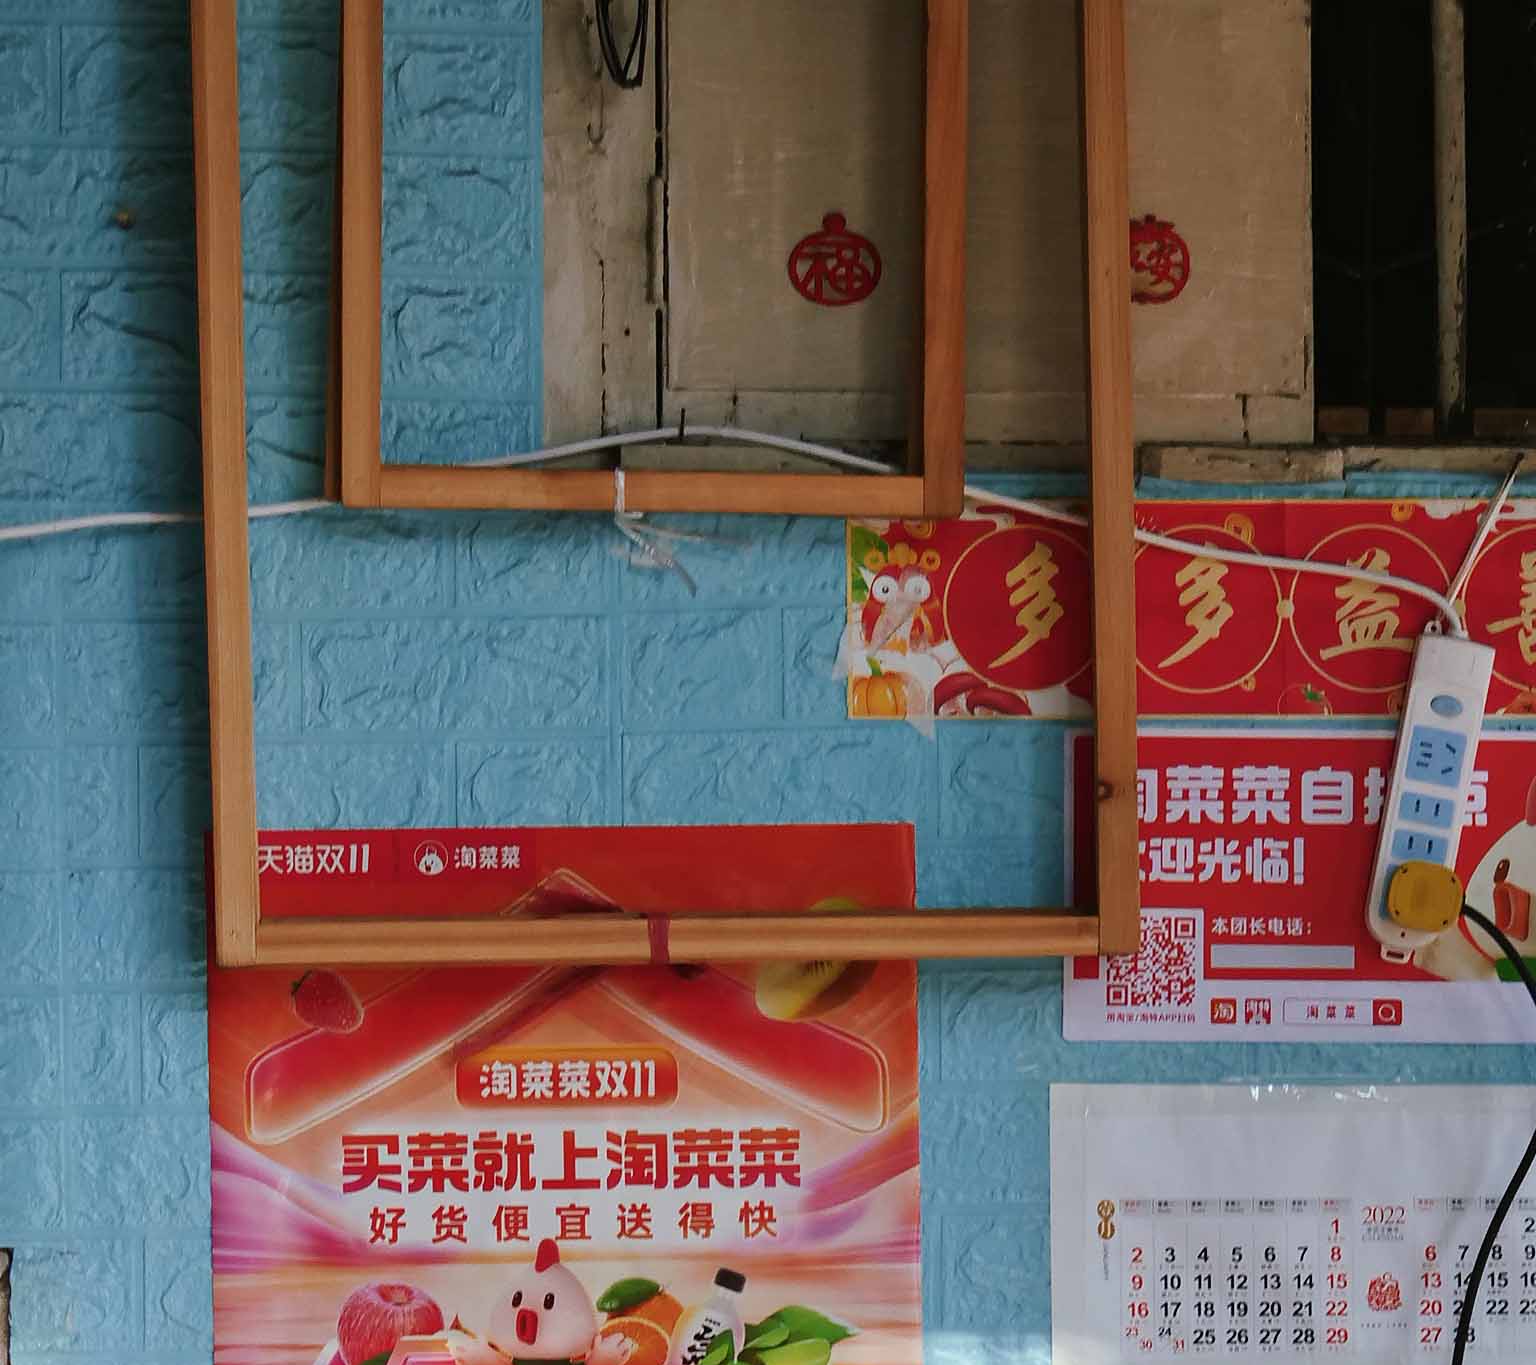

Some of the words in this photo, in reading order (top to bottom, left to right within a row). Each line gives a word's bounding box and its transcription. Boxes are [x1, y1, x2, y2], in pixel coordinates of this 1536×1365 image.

[258, 842, 370, 875] 天猫双11
[453, 844, 522, 871] 淘菜菜
[1138, 837, 1305, 886] 迎光临!
[479, 1059, 657, 1099] 淘菜菜双11
[341, 1127, 801, 1193] 买菜就上淘菜菜
[369, 1200, 778, 1245] 好货便宜送得快
[1362, 1206, 1407, 1226] 2022
[1524, 1216, 1536, 1233] 2
[1331, 1218, 1339, 1234] 1
[1131, 1246, 1143, 1264] 2
[1164, 1246, 1176, 1263] 3
[1197, 1246, 1210, 1263] 4
[1231, 1246, 1243, 1263] 5
[1264, 1245, 1276, 1263] 6
[1297, 1245, 1309, 1263] 7
[1330, 1245, 1342, 1263] 8
[1424, 1245, 1437, 1262] 6
[1458, 1244, 1470, 1262] 7
[1491, 1244, 1503, 1262] 8
[1524, 1244, 1536, 1261] 9
[1131, 1274, 1144, 1291] 9
[1159, 1273, 1182, 1291] 10
[1193, 1273, 1212, 1291] 11
[1226, 1273, 1248, 1291] 12
[1259, 1273, 1282, 1291] 13
[1293, 1273, 1315, 1291] 14
[1326, 1272, 1348, 1290] 15
[1420, 1271, 1442, 1289] 13
[1487, 1271, 1509, 1289] 15
[1127, 1301, 1149, 1319] 16
[1159, 1301, 1182, 1319] 17
[1193, 1300, 1216, 1318] 18
[1226, 1300, 1249, 1318] 19
[1258, 1300, 1282, 1318] 20
[1292, 1300, 1313, 1318] 21
[1325, 1300, 1348, 1317] 22
[1420, 1299, 1443, 1316] 20
[1485, 1298, 1509, 1316] 22
[1125, 1326, 1139, 1338] 23
[1158, 1326, 1172, 1338] 24
[1192, 1328, 1216, 1345] 25
[1226, 1328, 1249, 1345] 26
[1258, 1327, 1282, 1345] 27
[1292, 1327, 1316, 1345] 28
[1326, 1327, 1349, 1345] 29
[1420, 1327, 1443, 1344] 27
